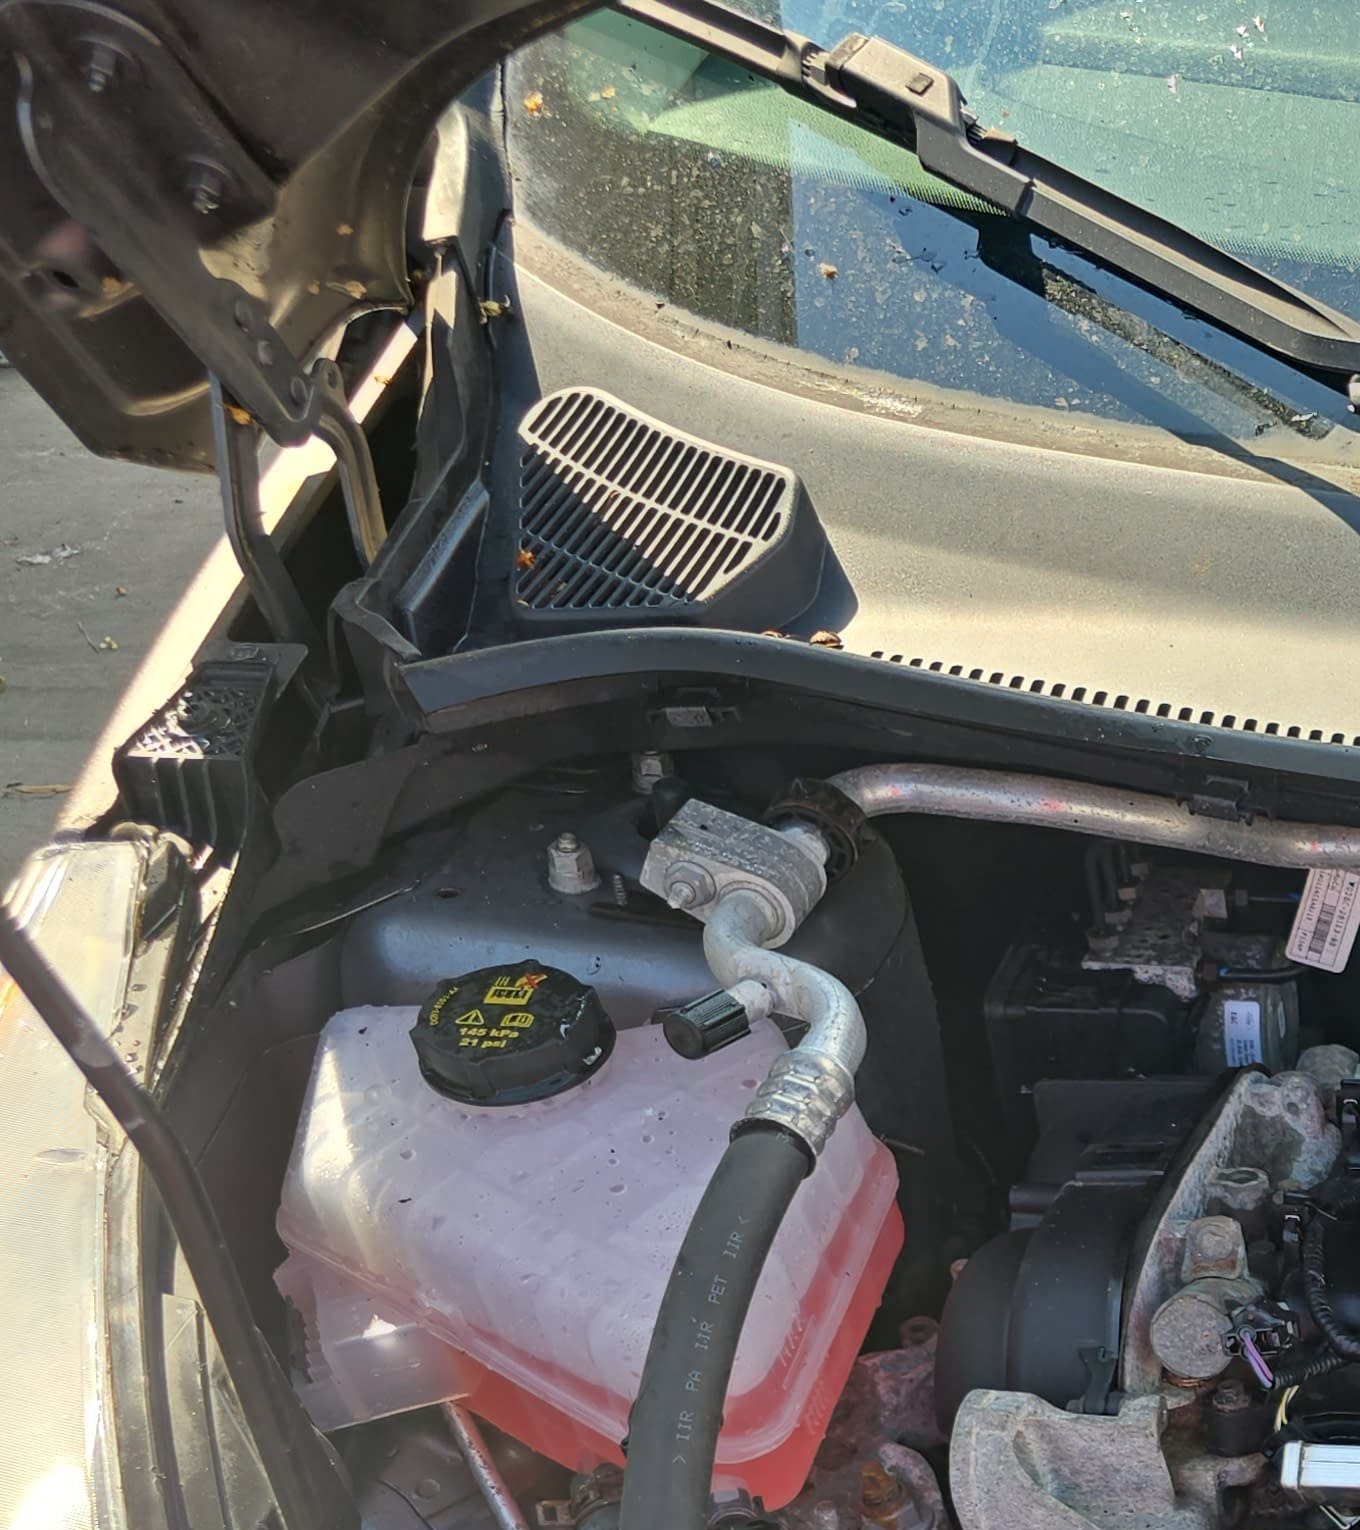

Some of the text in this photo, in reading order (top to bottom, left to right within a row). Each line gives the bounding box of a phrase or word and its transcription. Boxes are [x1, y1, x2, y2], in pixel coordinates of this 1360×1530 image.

[459, 1027, 520, 1039] 145 kPa
[458, 1037, 508, 1049] 21 psi
[707, 1274, 728, 1306] PET
